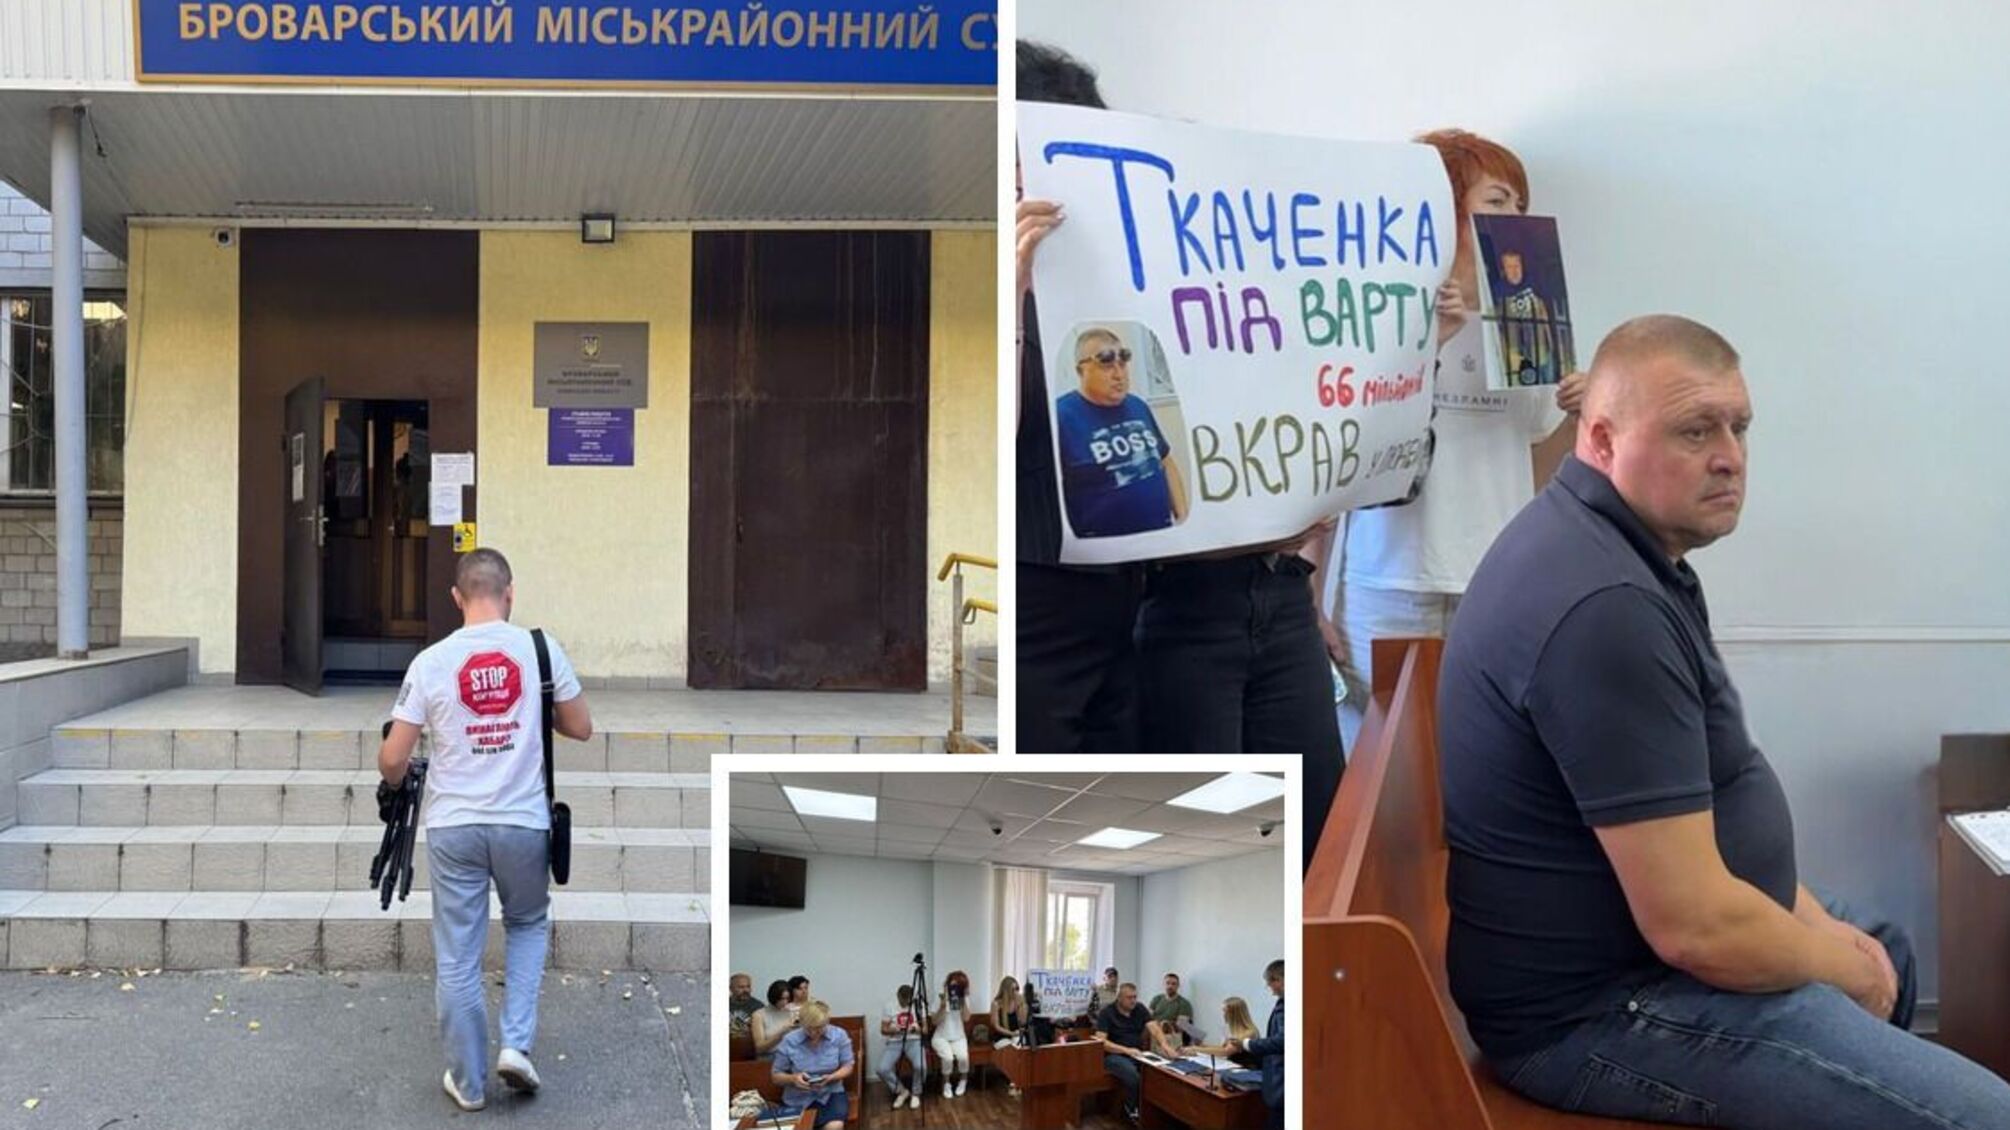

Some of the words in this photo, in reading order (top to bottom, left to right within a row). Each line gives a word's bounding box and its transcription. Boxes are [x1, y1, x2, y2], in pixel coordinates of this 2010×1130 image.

[179, 0, 513, 43] БРОВАРСЬКИЙ
[536, 2, 939, 50] МІСЬКРАЙОННИЙ
[1300, 277, 1437, 354] ВАРТУ
[1317, 364, 1355, 408] 66
[1089, 429, 1158, 465] BOSS
[1192, 414, 1361, 502] ВКРАВ
[470, 666, 508, 691] STOP
